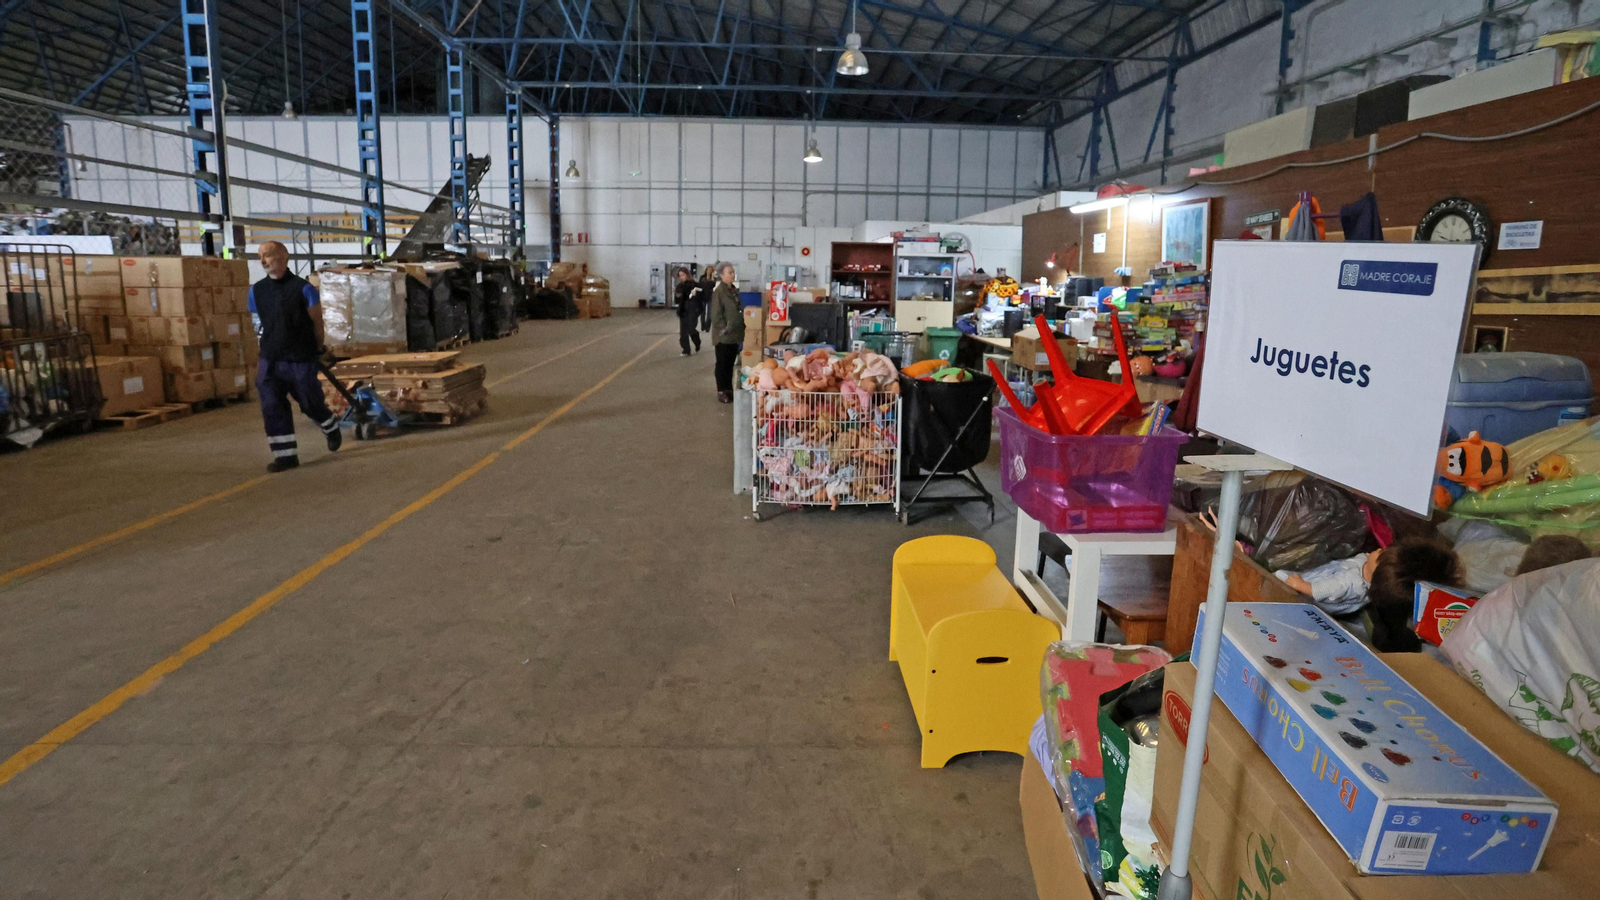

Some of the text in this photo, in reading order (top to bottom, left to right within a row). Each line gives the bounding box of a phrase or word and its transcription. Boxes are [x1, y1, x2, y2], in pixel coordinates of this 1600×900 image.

[1360, 271, 1432, 285] MADRE CORAJE
[1250, 337, 1371, 388] Juguetes
[1303, 609, 1350, 645] AMAYA
[1168, 697, 1189, 735] TORR
